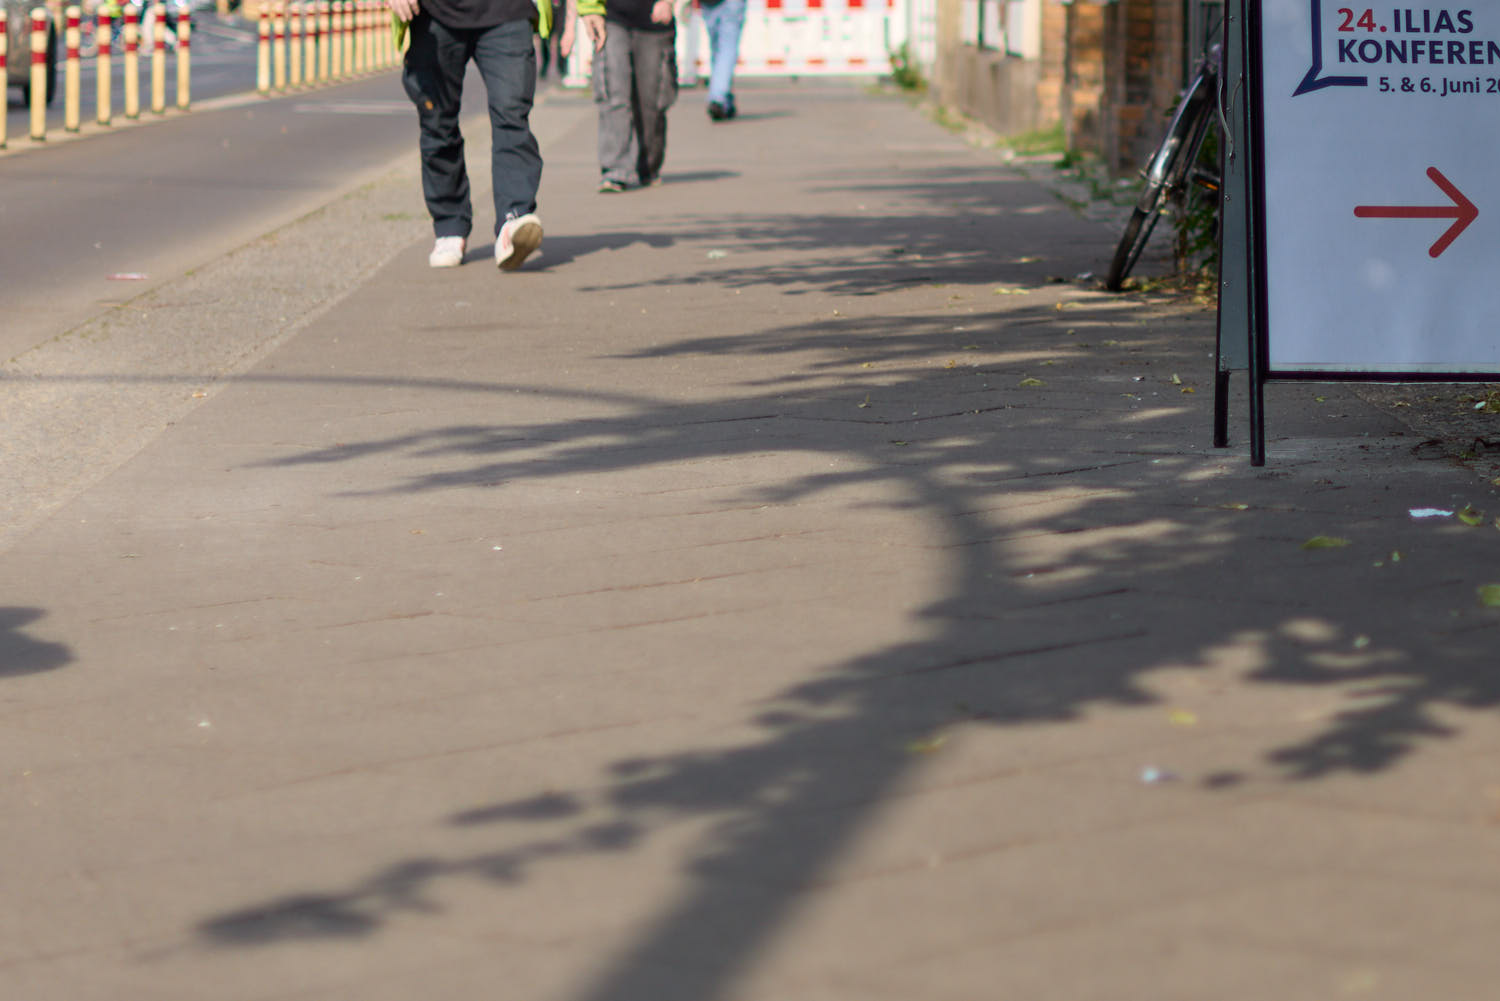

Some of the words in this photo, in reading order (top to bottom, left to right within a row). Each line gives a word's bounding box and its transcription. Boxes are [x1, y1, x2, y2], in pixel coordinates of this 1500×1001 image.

[1337, 8, 1387, 32] 24.
[1393, 9, 1474, 33] ILIAS
[1379, 77, 1396, 92] 5.
[1401, 77, 1416, 93] &
[1420, 77, 1437, 93] 6.
[1441, 77, 1481, 97] Juni
